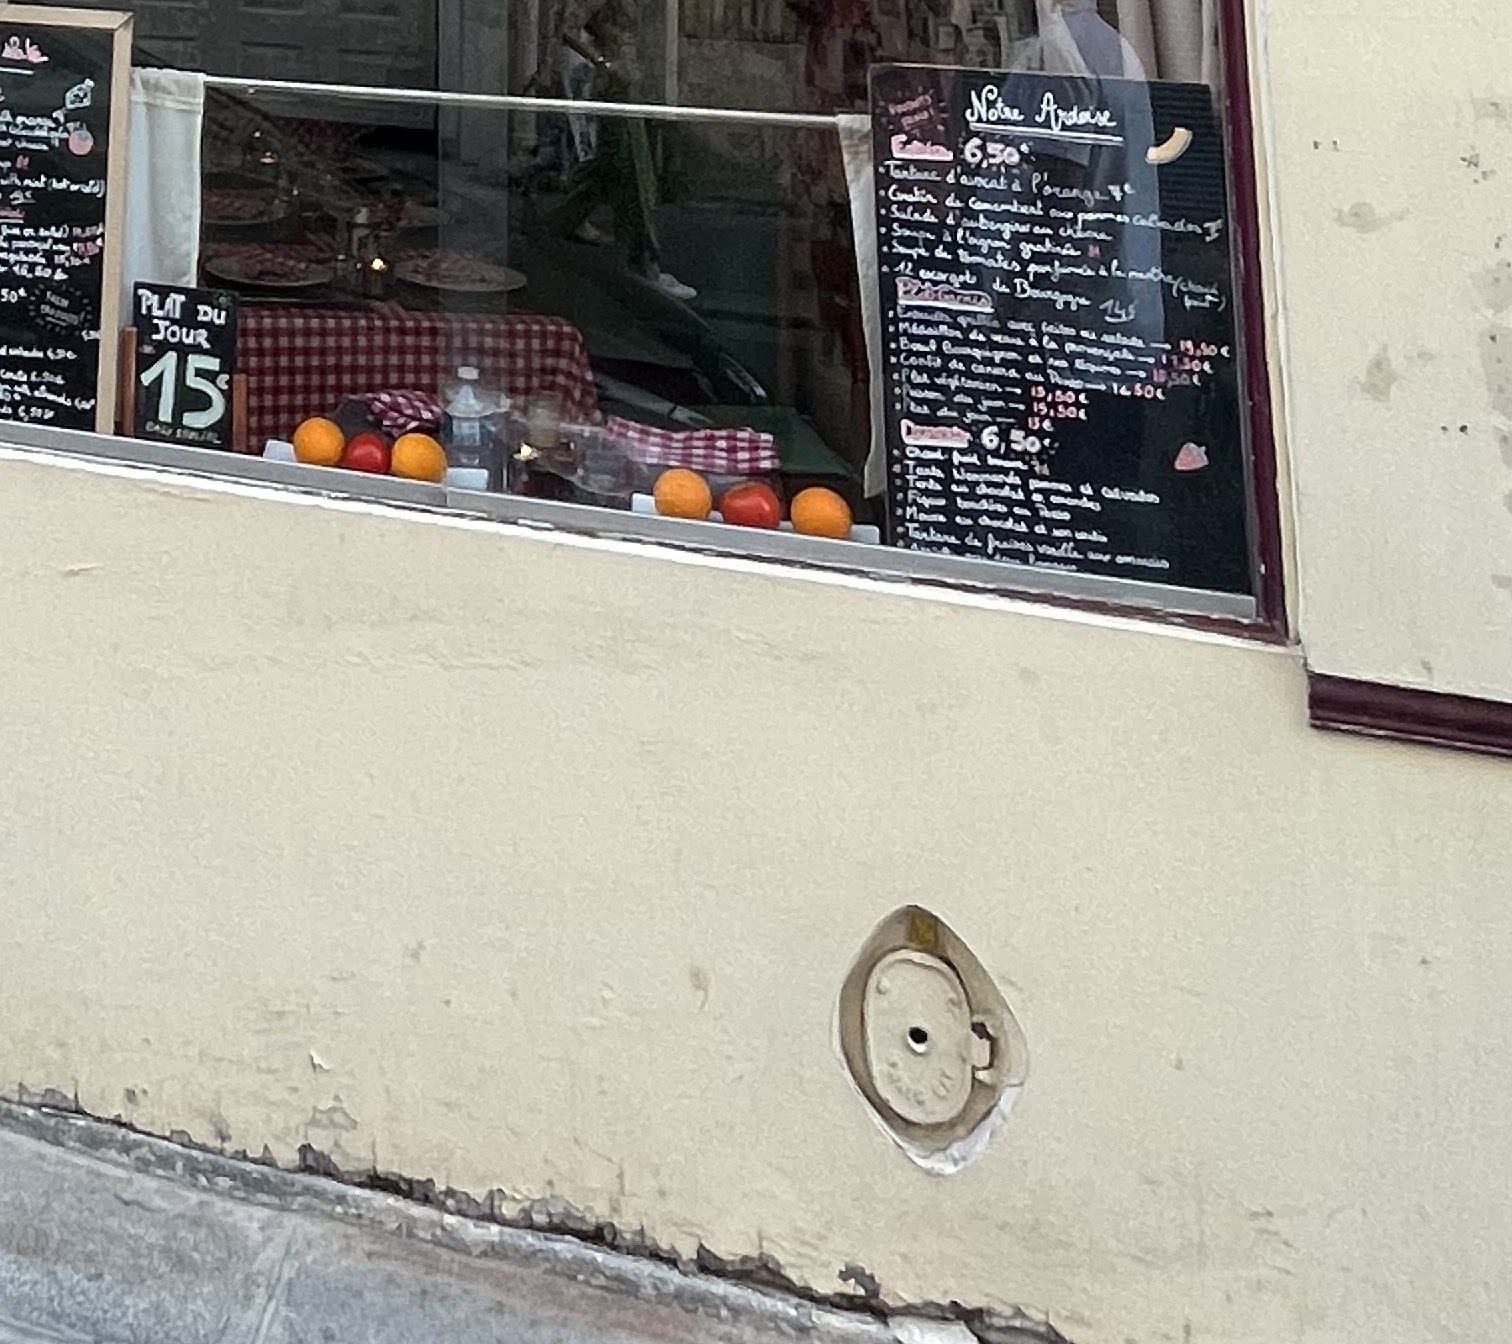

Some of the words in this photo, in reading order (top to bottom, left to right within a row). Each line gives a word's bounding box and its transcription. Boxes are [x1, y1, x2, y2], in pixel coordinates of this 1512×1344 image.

[965, 83, 1025, 123] Notre
[1034, 92, 1117, 132] Ardoise
[137, 288, 186, 319] PLAT
[196, 304, 227, 325] DU
[151, 318, 211, 349] JOUR
